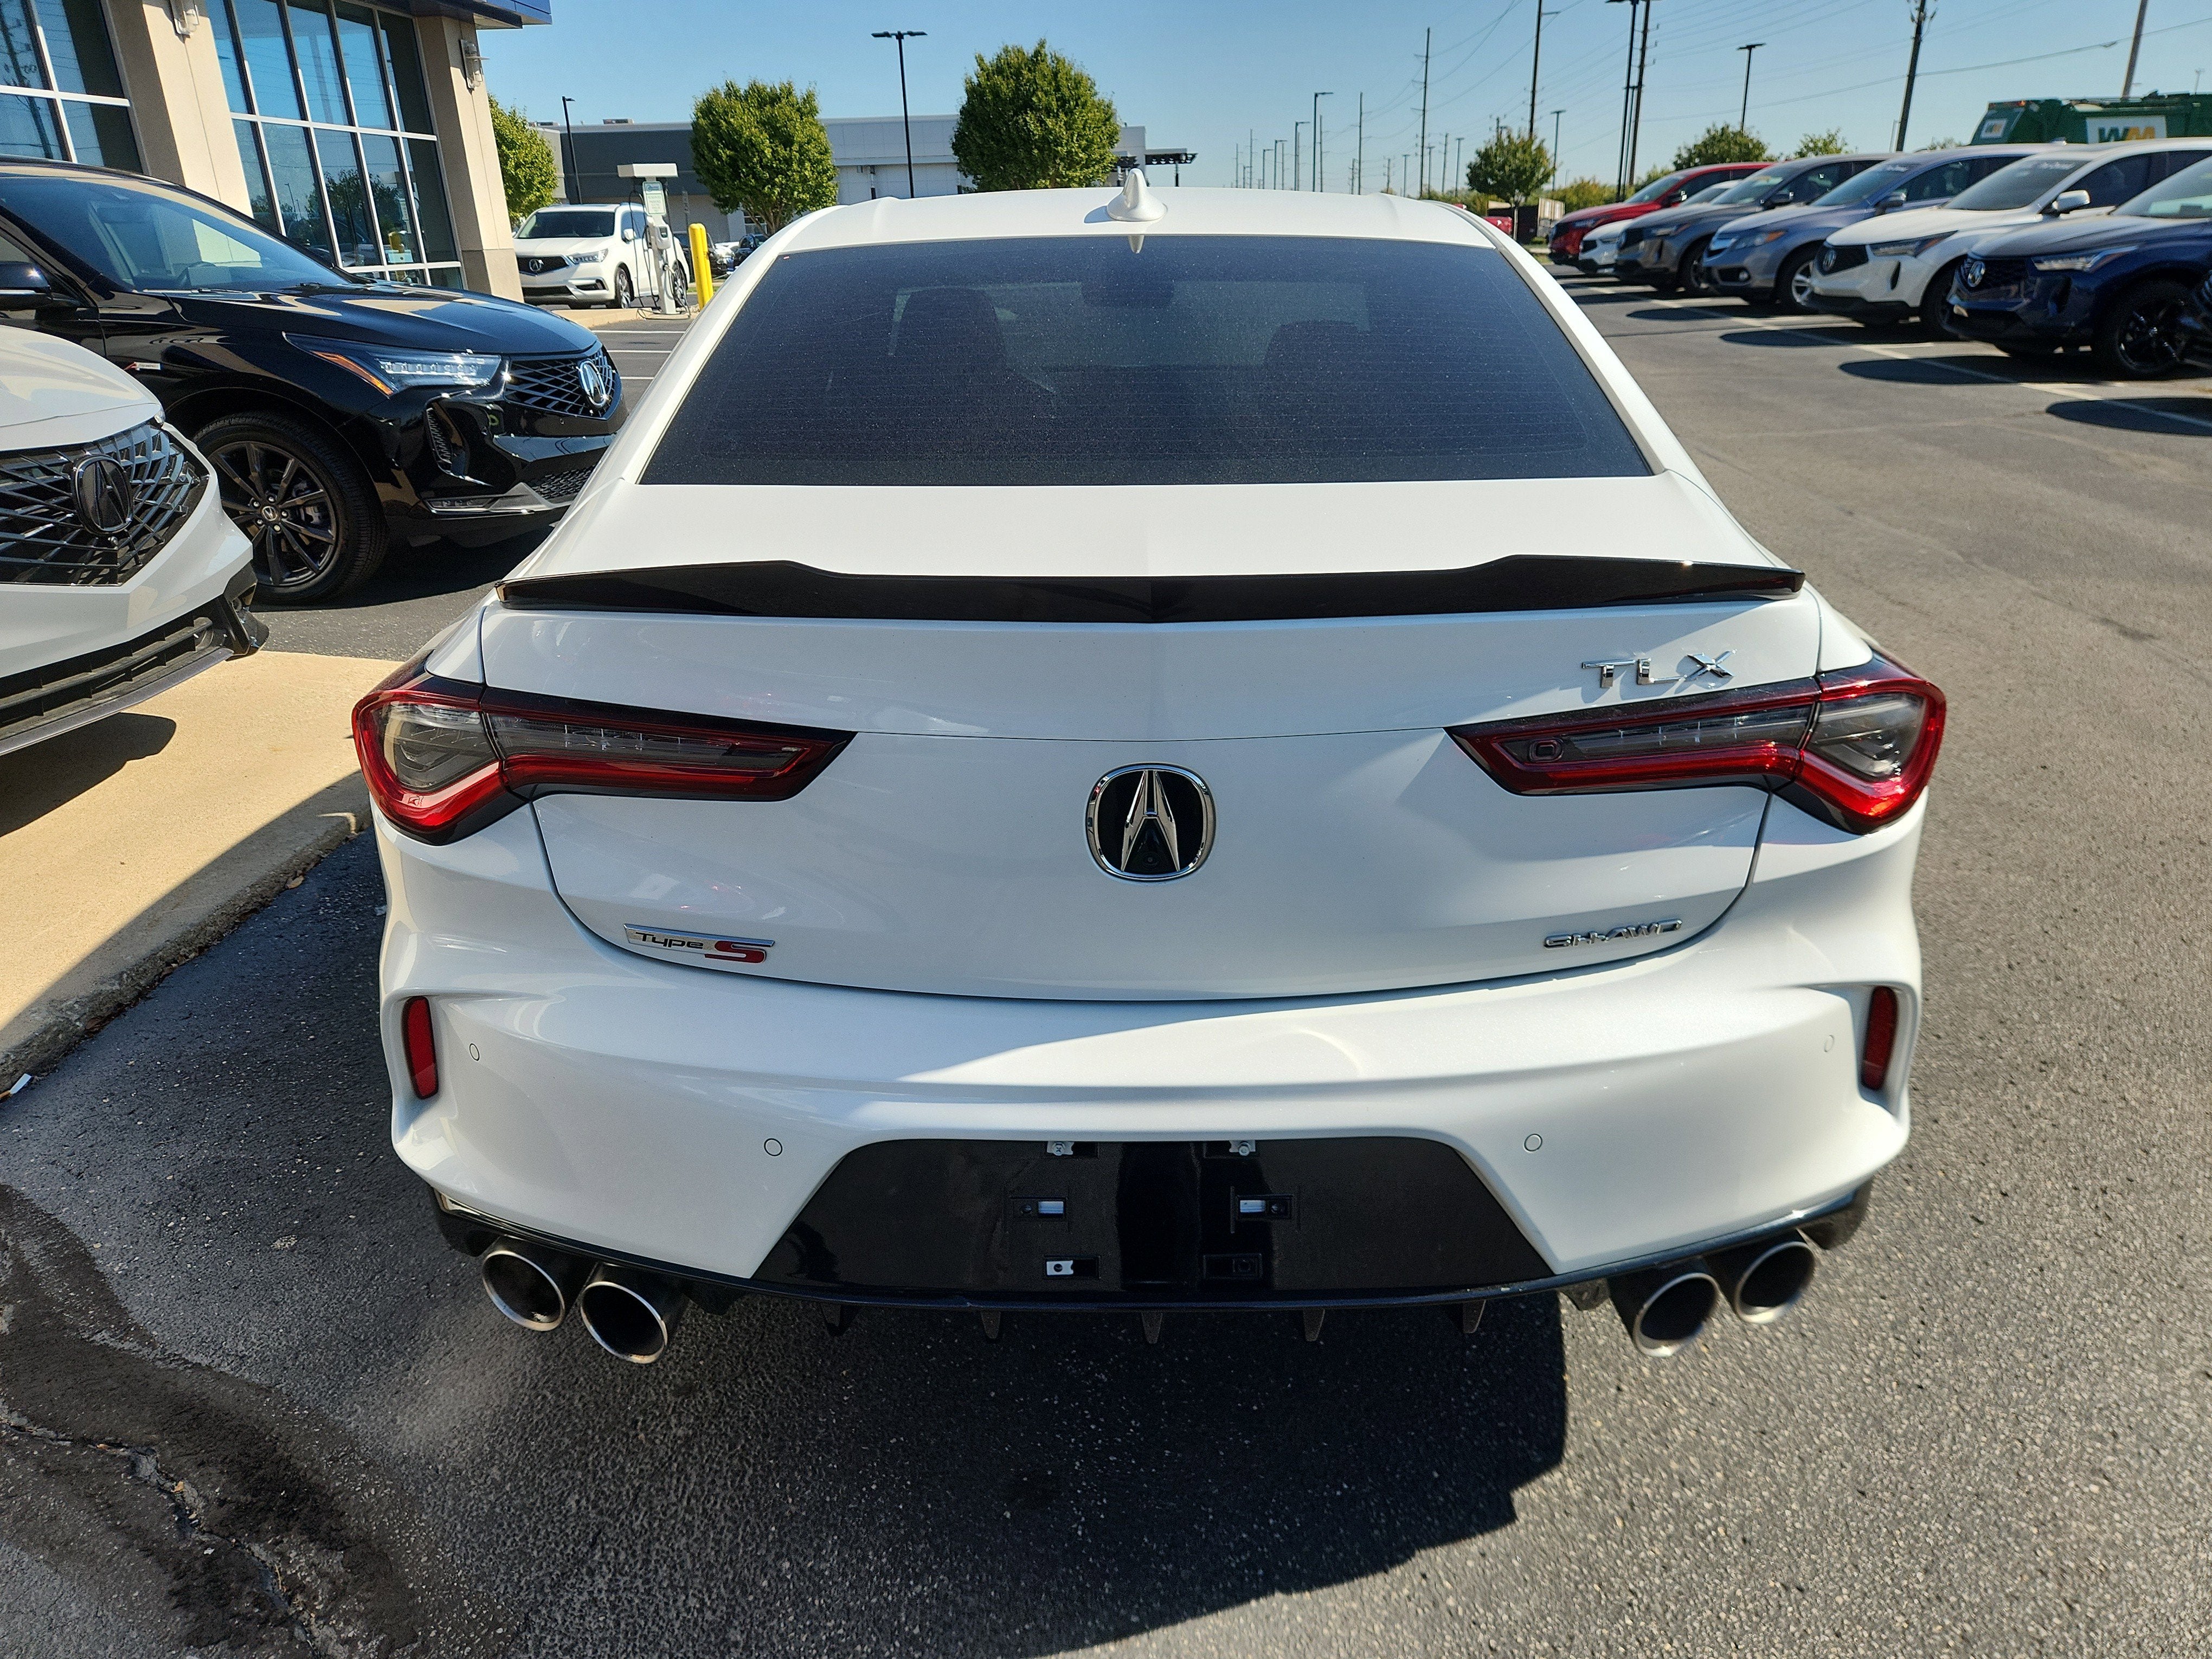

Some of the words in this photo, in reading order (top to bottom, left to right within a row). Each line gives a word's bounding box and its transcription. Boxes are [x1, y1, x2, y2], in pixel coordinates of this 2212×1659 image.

[2098, 126, 2156, 143] WM
[1581, 649, 1736, 689] TLX
[635, 931, 704, 950] Type
[704, 940, 768, 964] S
[1544, 918, 1682, 950] SH-AWD
